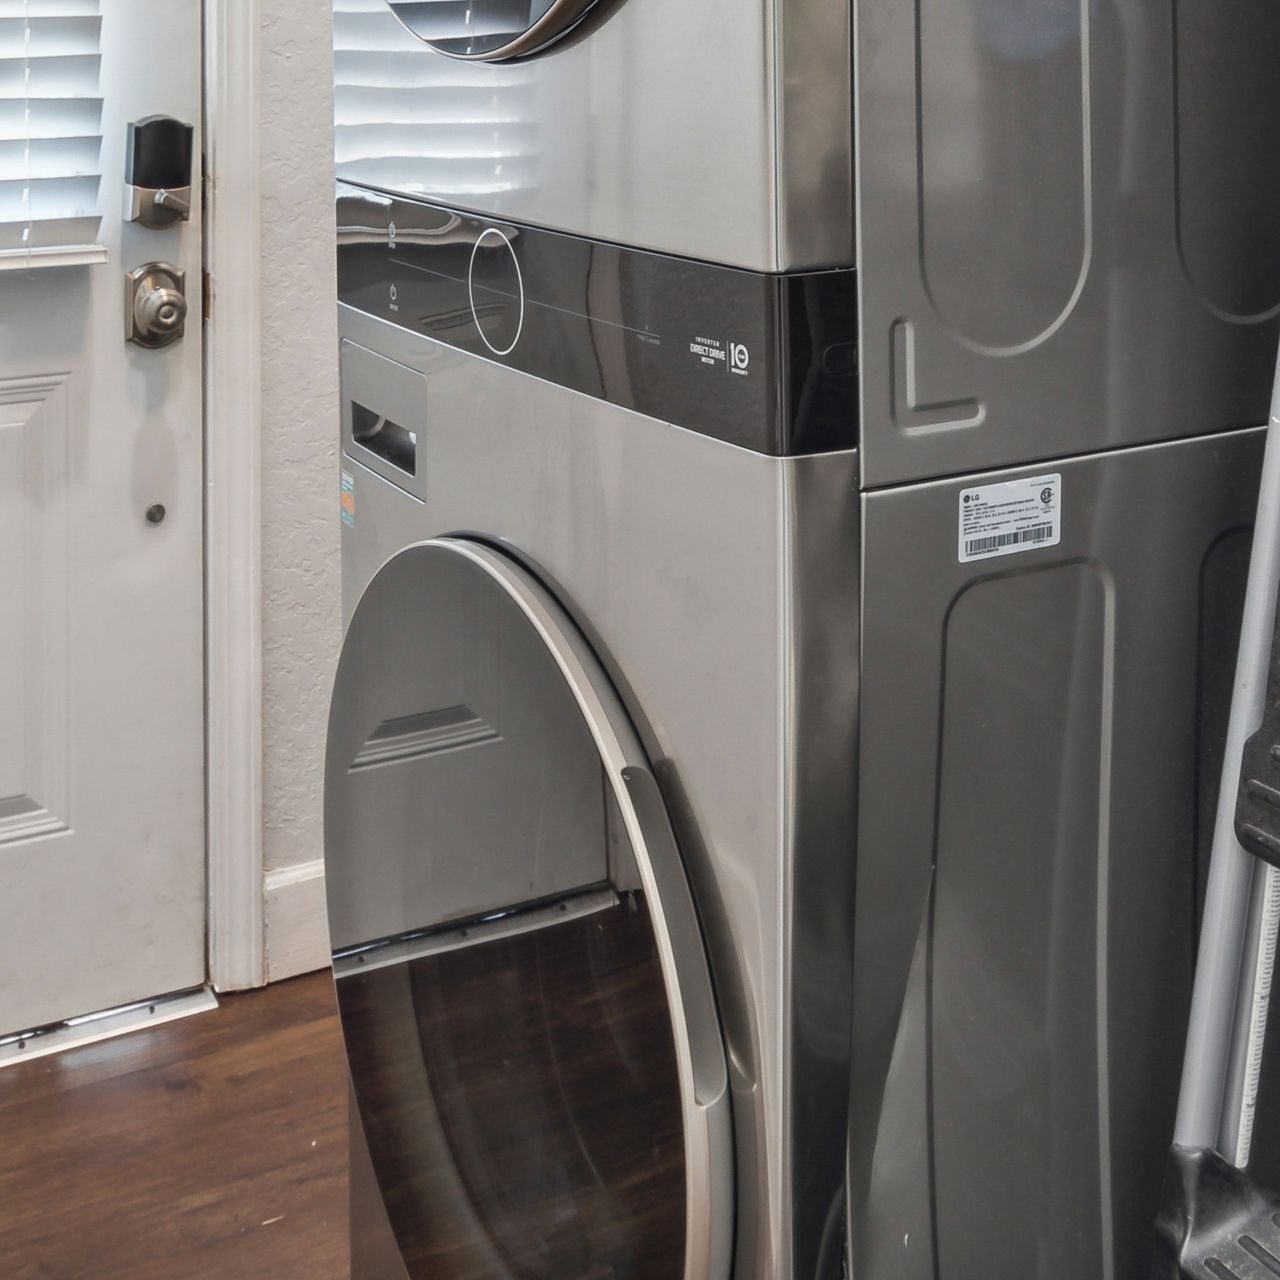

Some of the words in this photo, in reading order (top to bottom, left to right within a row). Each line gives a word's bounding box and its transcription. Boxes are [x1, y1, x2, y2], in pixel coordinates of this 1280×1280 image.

[695, 336, 720, 347] INVERTER
[690, 343, 709, 356] DIRECT
[709, 348, 726, 360] DRIVE
[730, 342, 749, 369] 10
